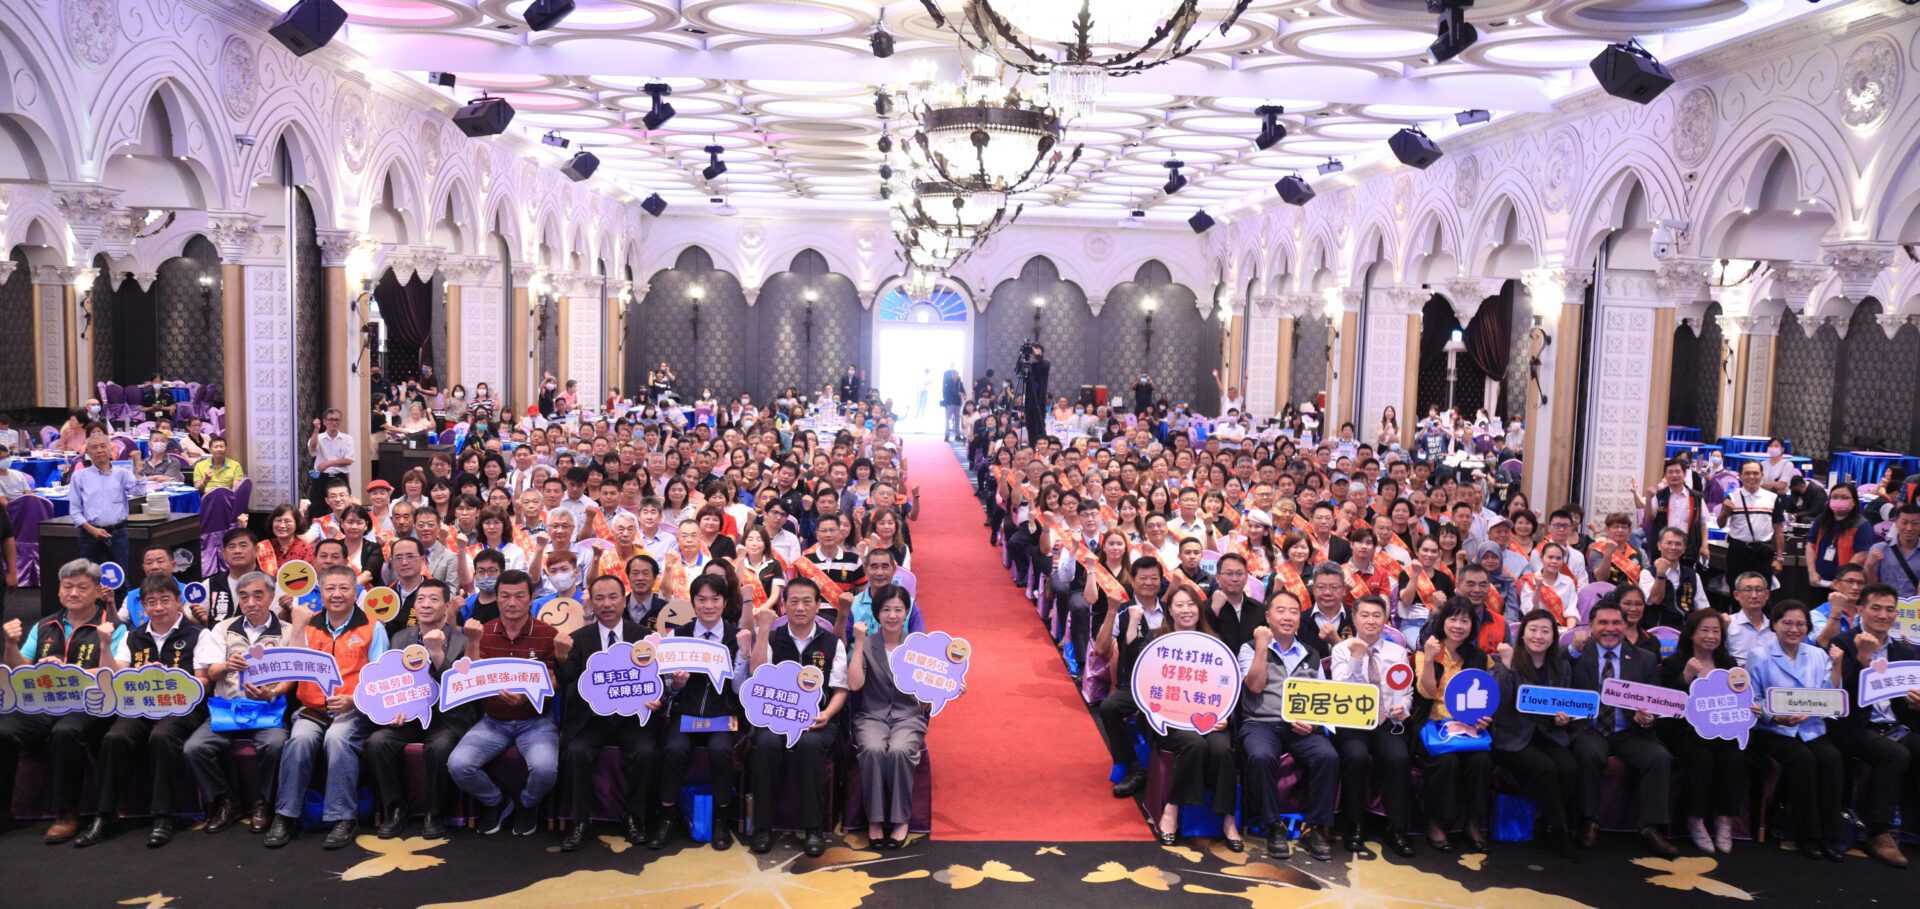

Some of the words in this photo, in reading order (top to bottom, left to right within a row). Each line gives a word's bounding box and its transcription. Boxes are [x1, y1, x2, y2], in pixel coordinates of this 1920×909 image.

[247, 661, 331, 676] 最棒的工會底家!
[593, 669, 640, 684] 攜手工會
[1161, 664, 1208, 684] 好夥伴
[23, 675, 80, 690] 最棒工會
[124, 678, 177, 692] 我的工會
[366, 674, 413, 695] 幸福勞動
[451, 671, 541, 693] 勞工最堅強a後盾
[914, 670, 956, 691] 幸福臺中
[1870, 674, 1920, 691] 職業安全
[384, 686, 430, 708] 豐富生活
[608, 685, 655, 699] 保障勞權
[753, 684, 799, 704] 勞資和諧
[1605, 688, 1621, 698] Aku
[1623, 692, 1645, 702] cinta
[1646, 696, 1686, 711] Taichung
[1288, 692, 1375, 715] 宜居台中
[1522, 695, 1526, 703] I
[1529, 696, 1549, 705] love
[1551, 698, 1596, 711] Taichung.
[1697, 696, 1736, 711] 勞資和諧
[763, 703, 809, 722] 富市臺中
[1711, 709, 1751, 723] 幸福共好
